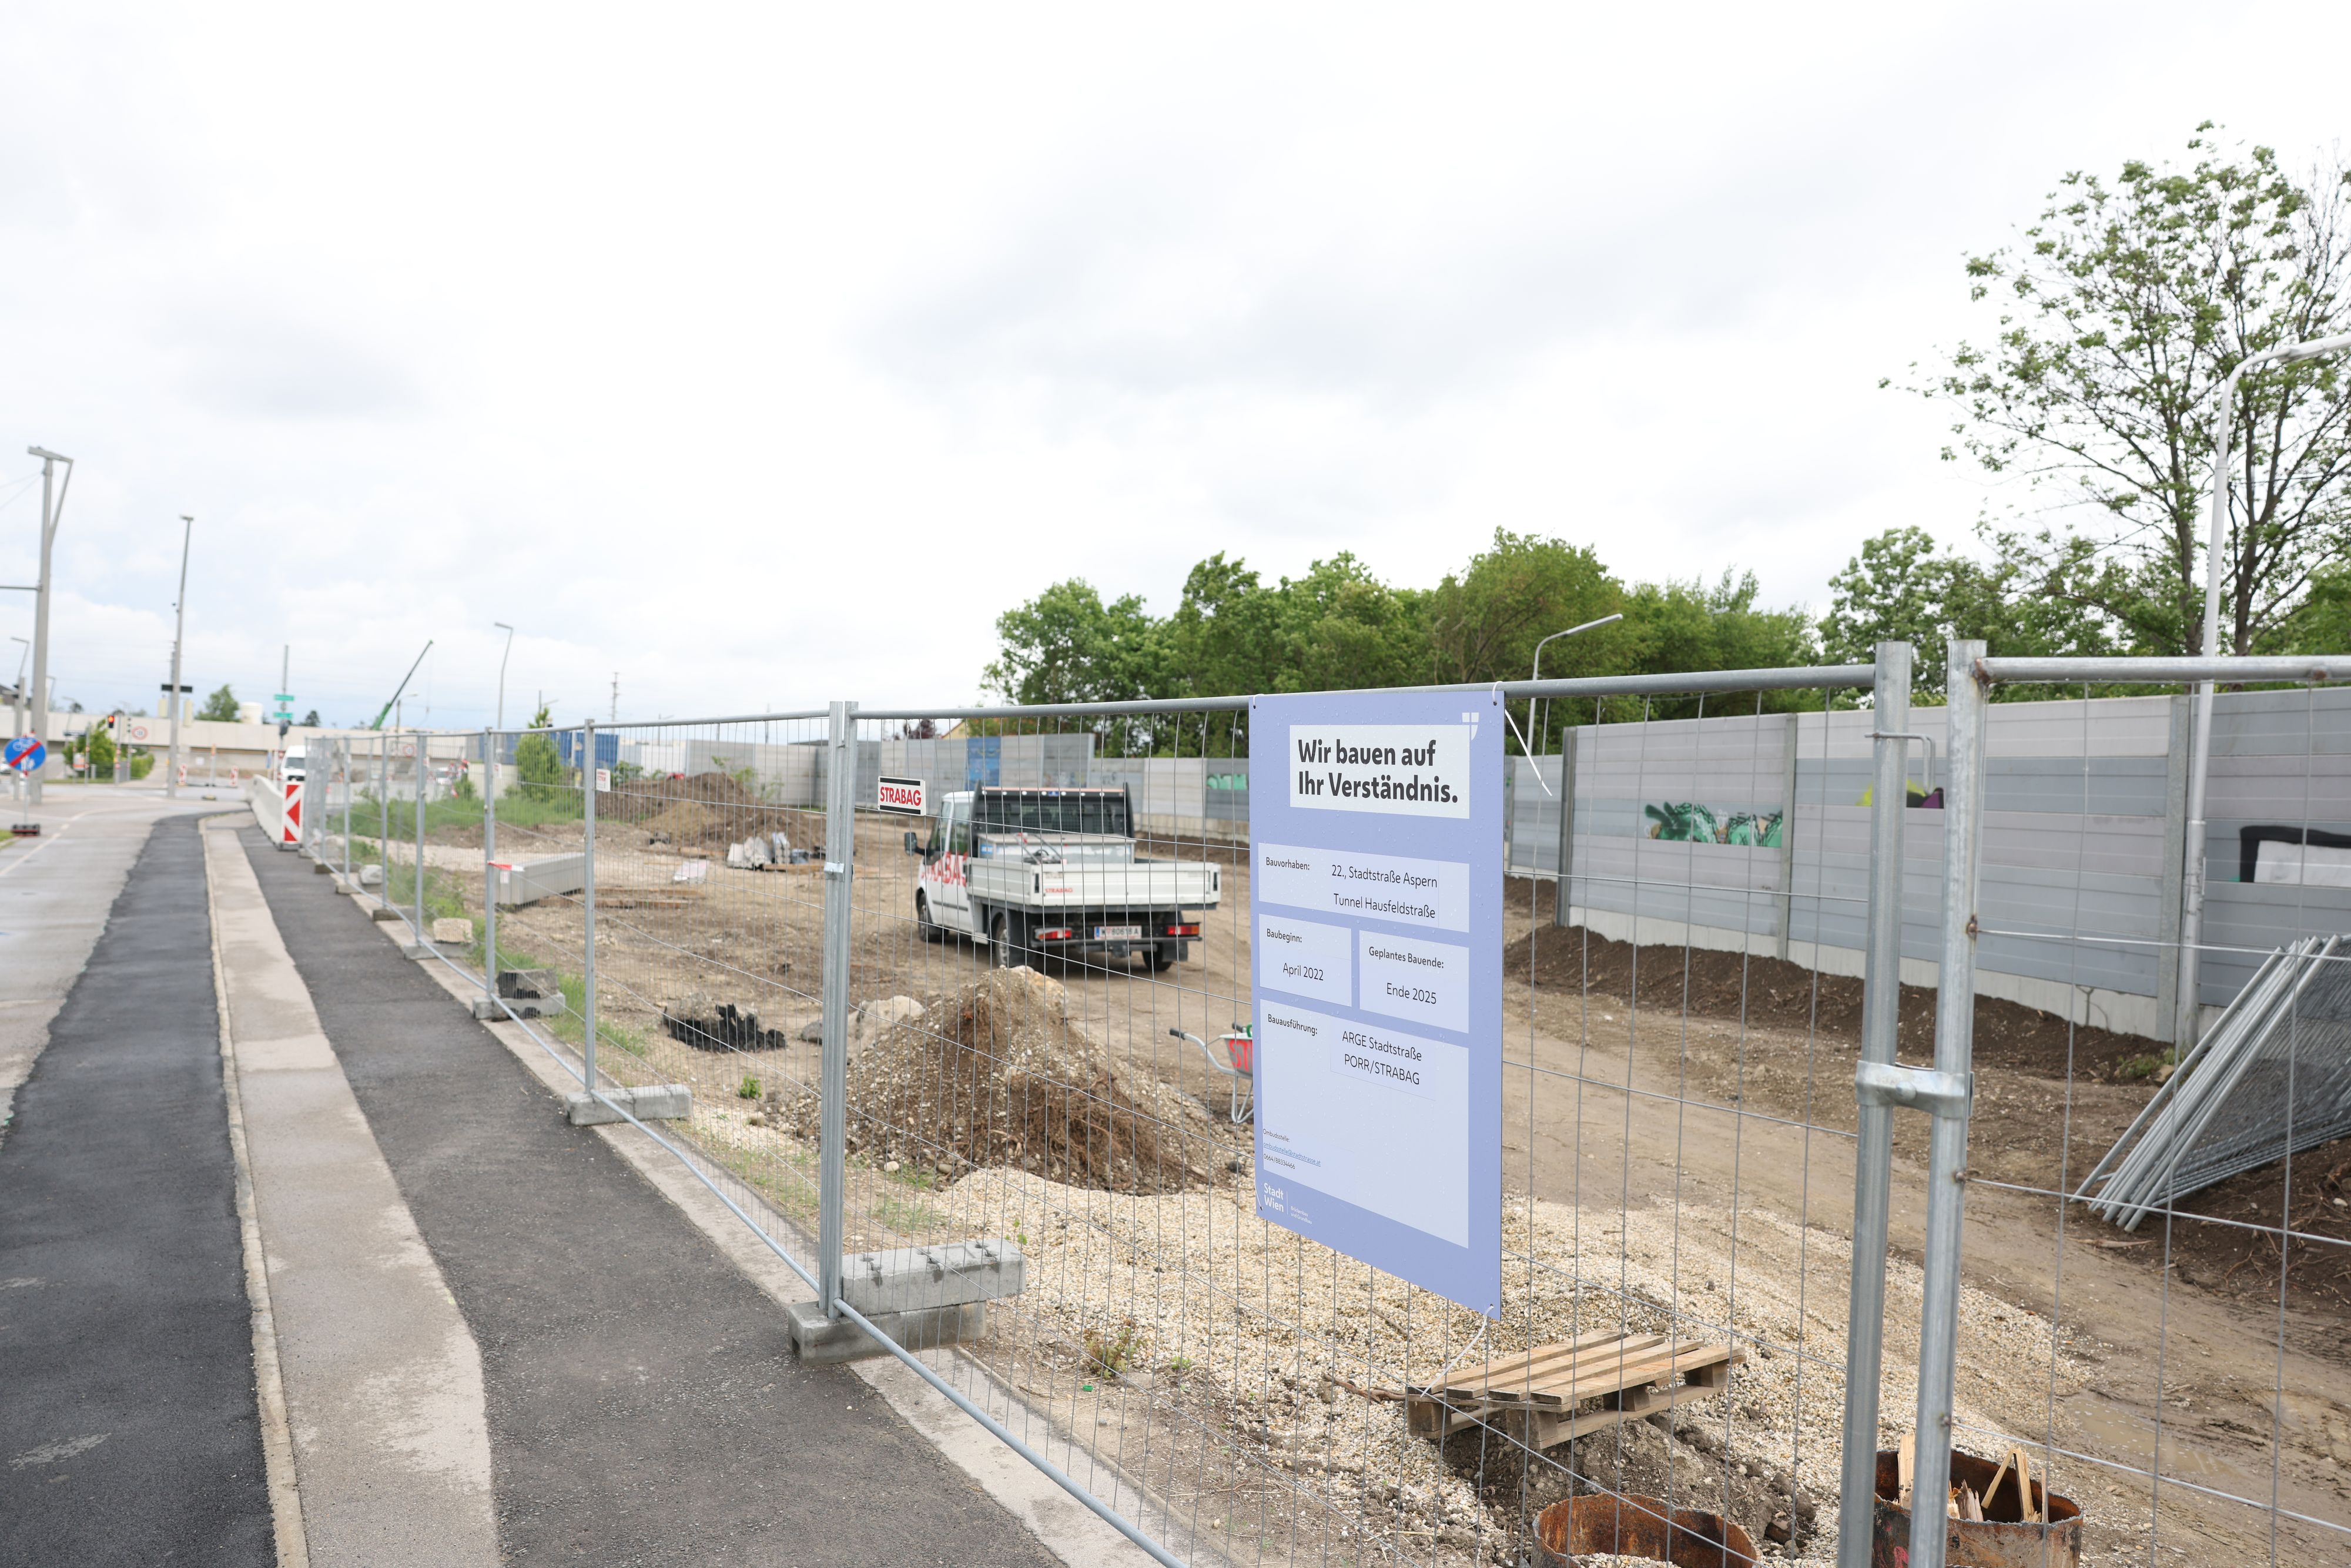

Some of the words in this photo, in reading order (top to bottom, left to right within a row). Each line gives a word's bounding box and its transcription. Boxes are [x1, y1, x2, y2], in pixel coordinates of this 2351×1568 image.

[1298, 739, 1331, 763] Wir
[1336, 739, 1396, 765] bauen
[1401, 740, 1436, 766] auf
[880, 786, 922, 806] STRABAG
[1299, 771, 1324, 796] Ihr
[1329, 772, 1458, 803] Verständnis.
[1265, 856, 1310, 870] Bauvorhaben:
[1331, 865, 1347, 880] 22.,
[1349, 867, 1401, 884] Stadtstraße
[1403, 873, 1438, 889] Aspern
[1334, 893, 1363, 908] Tunnel
[1365, 897, 1435, 919] Hausfeldstraße
[1267, 929, 1302, 945] Baubeginn:
[1368, 946, 1406, 962] Geplantes
[1408, 953, 1444, 969] Bauende:
[1282, 962, 1301, 977] April
[1304, 966, 1324, 981] 2022
[1387, 983, 1410, 999] Ende
[1412, 989, 1436, 1004] 2025
[1268, 1014, 1318, 1036] Bauausführung:
[1228, 1039, 1252, 1072] ST
[1342, 1030, 1367, 1047] ARGE
[1369, 1037, 1422, 1061] Stadtstraße
[1344, 1053, 1420, 1085] PORR/STRABAG
[1262, 1128, 1290, 1143] Ombudsstelle:
[1263, 1142, 1321, 1167] ombudsstelle@stadtstrasse.at
[1264, 1153, 1295, 1170] 0664/88334466
[1264, 1182, 1284, 1200] Stadt
[1264, 1195, 1284, 1212] Wien
